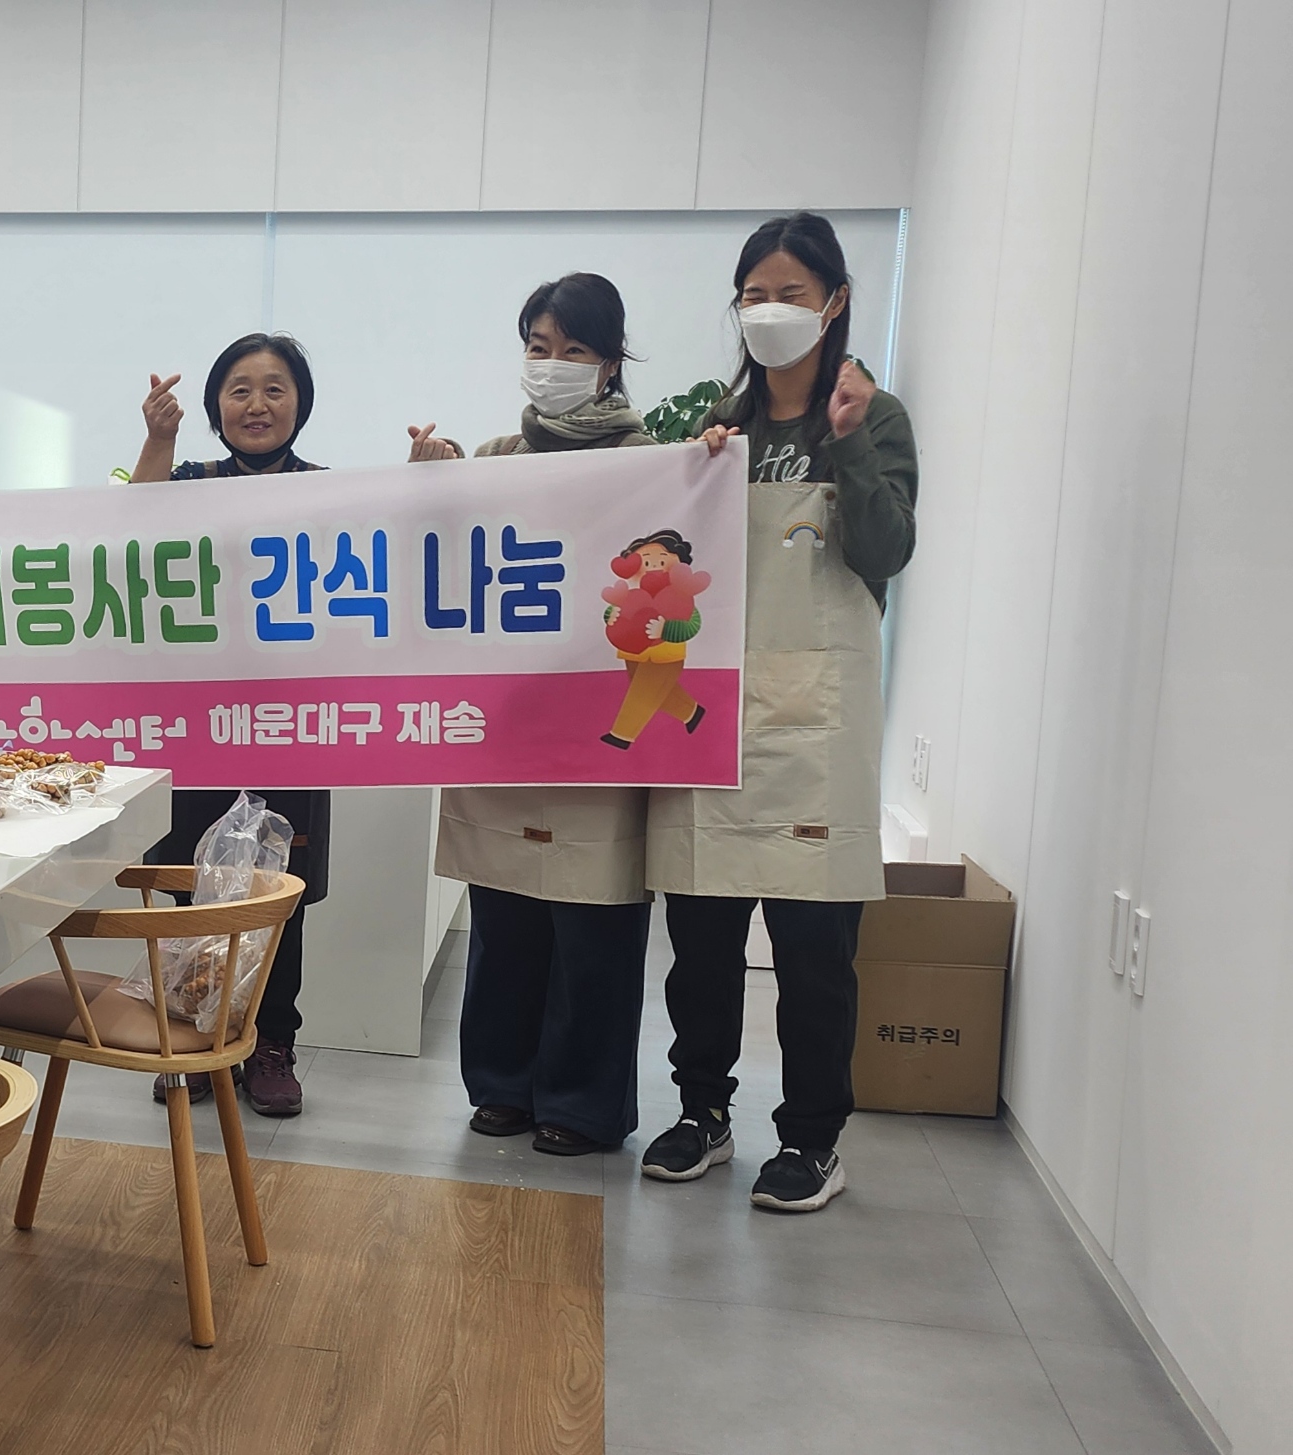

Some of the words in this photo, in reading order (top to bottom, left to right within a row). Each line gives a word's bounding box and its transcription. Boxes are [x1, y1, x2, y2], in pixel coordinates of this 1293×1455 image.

[250, 529, 389, 642] 간식
[424, 525, 565, 634] 나눔
[208, 702, 383, 745] 해운대구
[396, 700, 487, 745] 재송
[876, 1024, 961, 1046] 취급주의
